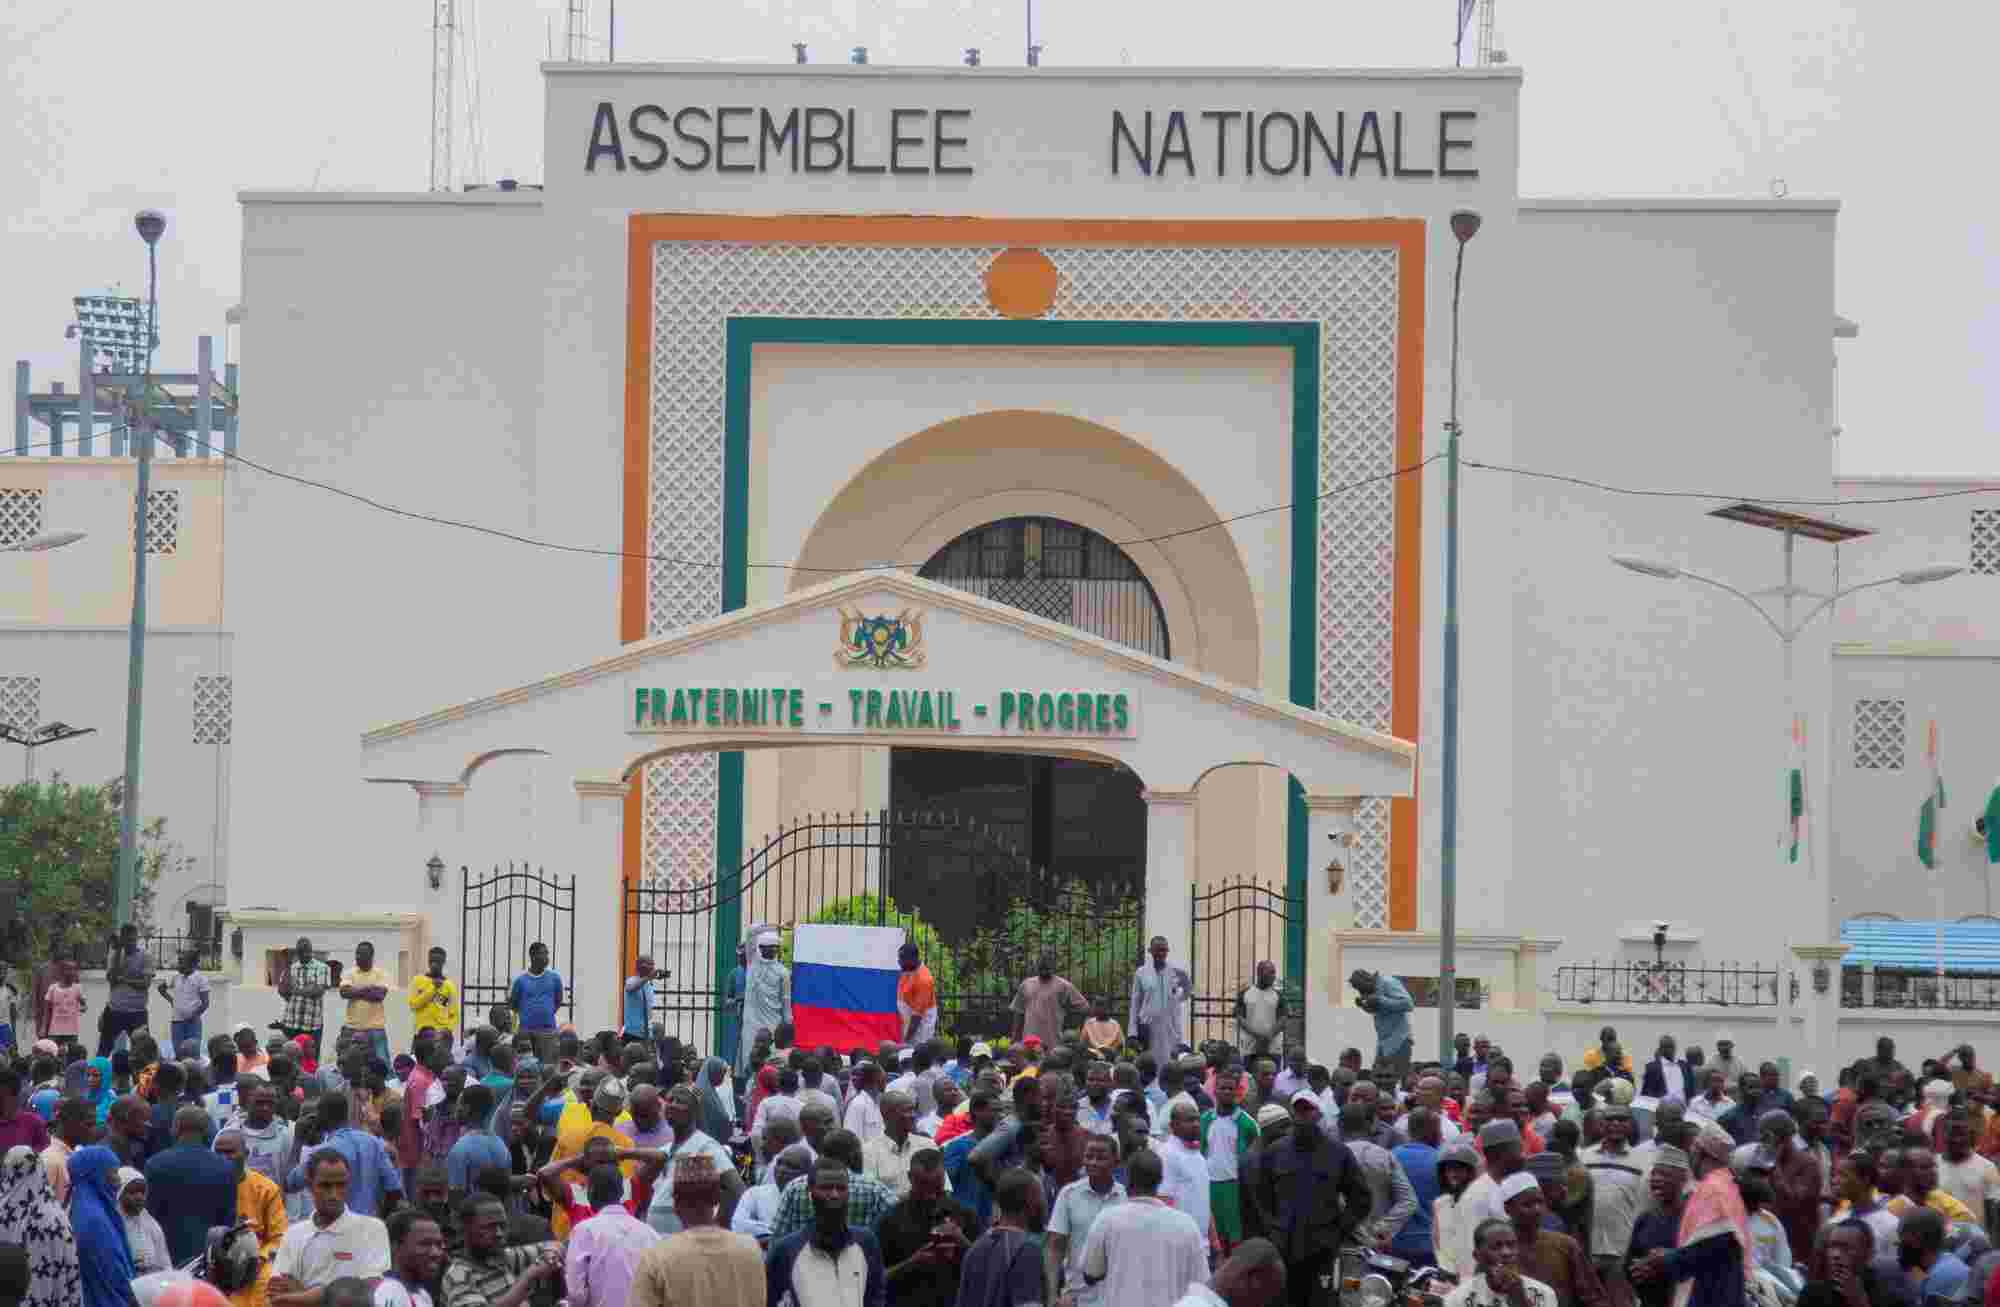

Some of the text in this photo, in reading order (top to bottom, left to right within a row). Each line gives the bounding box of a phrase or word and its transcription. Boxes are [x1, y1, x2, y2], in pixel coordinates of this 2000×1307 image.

[586, 102, 1479, 179] ASSEMBLEE NATIONALE
[635, 687, 804, 727] FRATERNITE
[849, 689, 961, 730] TRAVAIL
[1000, 692, 1129, 731] PROGRES
